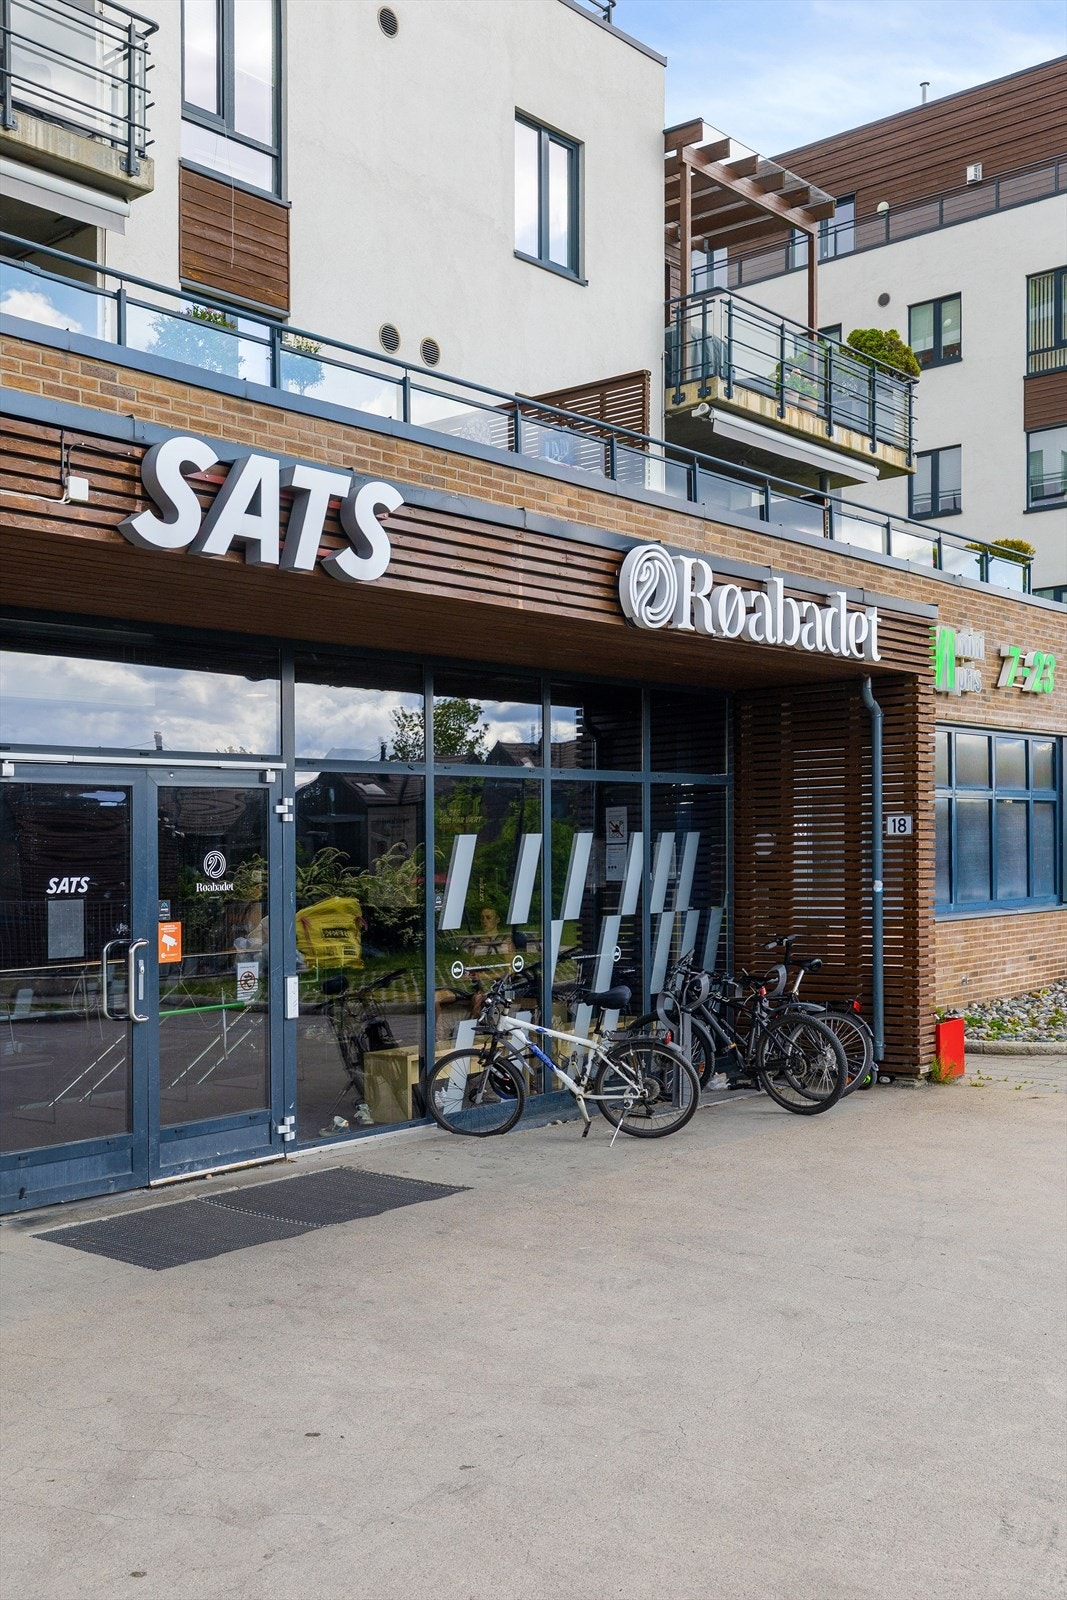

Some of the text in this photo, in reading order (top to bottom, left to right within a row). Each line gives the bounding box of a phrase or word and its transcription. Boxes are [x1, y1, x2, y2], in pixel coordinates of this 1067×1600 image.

[119, 436, 405, 583] SATS
[673, 555, 883, 662] Røabadet
[998, 644, 1057, 695] 7-23
[891, 817, 908, 834] 18
[46, 875, 91, 895] SATS
